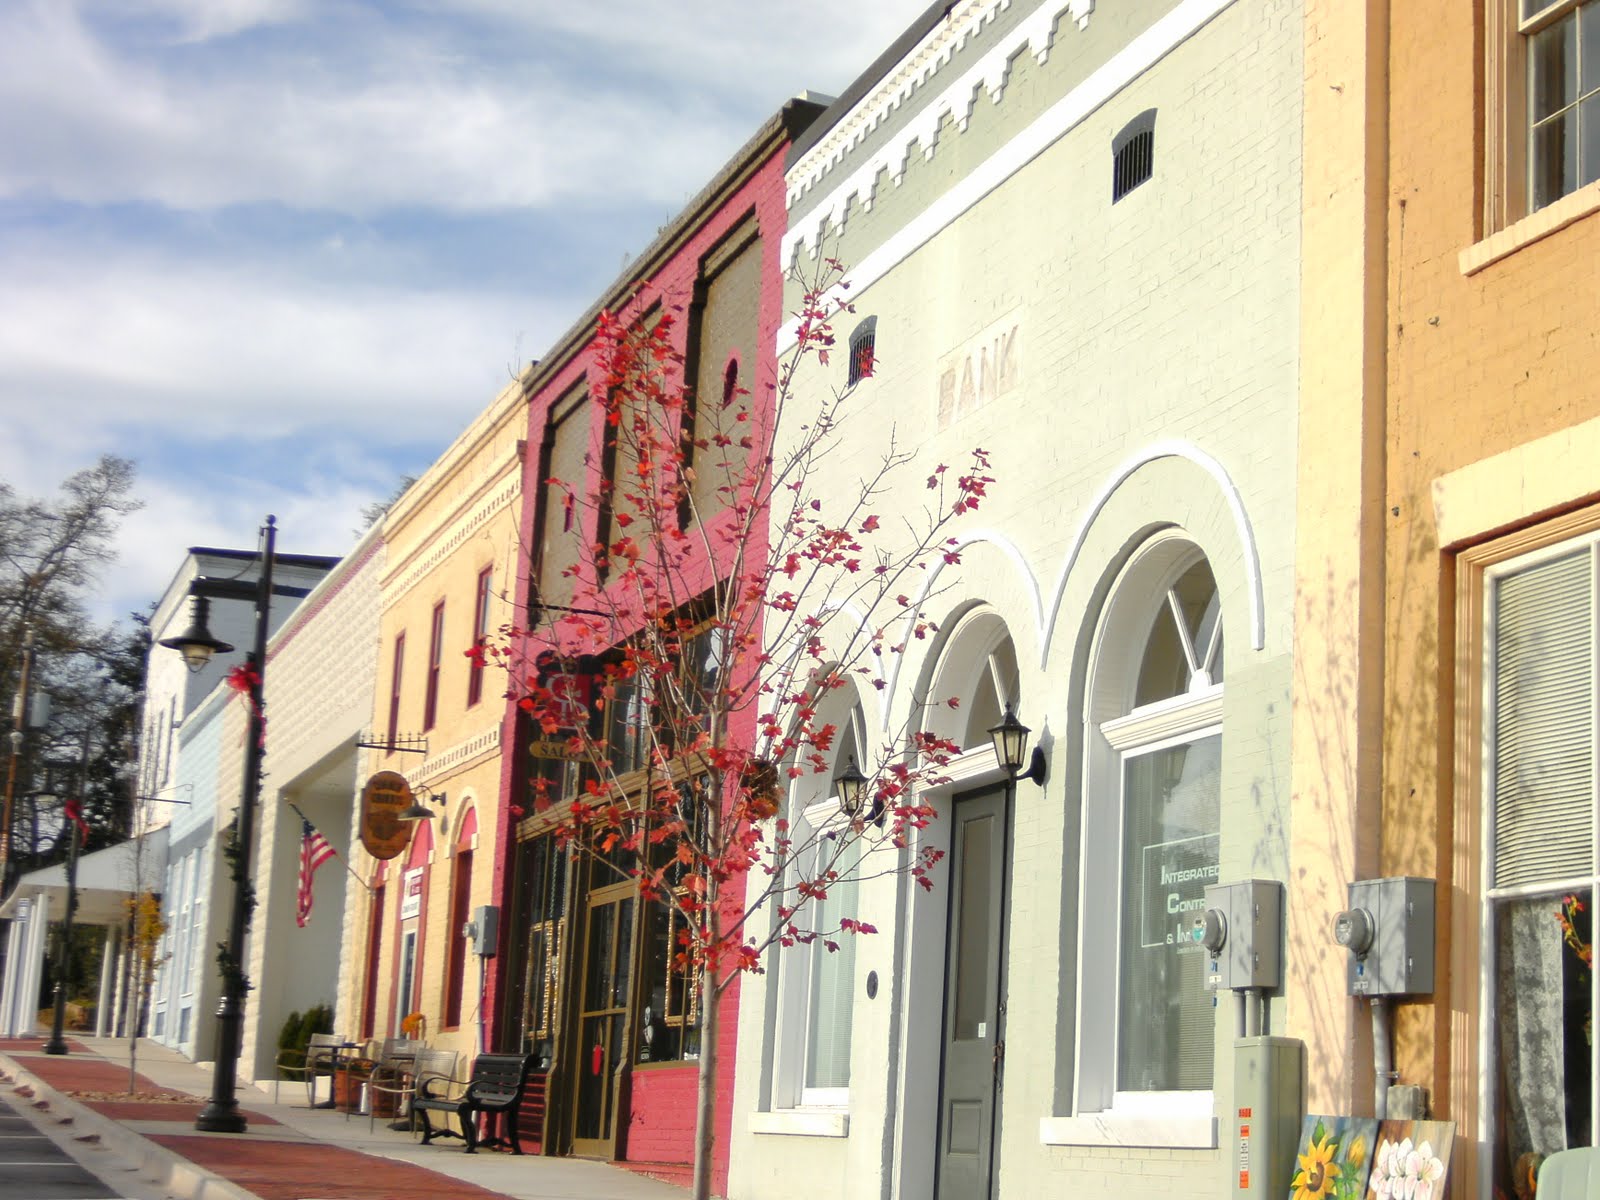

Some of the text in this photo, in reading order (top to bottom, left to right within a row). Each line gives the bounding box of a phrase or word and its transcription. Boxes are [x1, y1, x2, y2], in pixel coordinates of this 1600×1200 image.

[937, 325, 1018, 418] BANK
[541, 743, 590, 760] SAL
[1166, 933, 1174, 945] &
